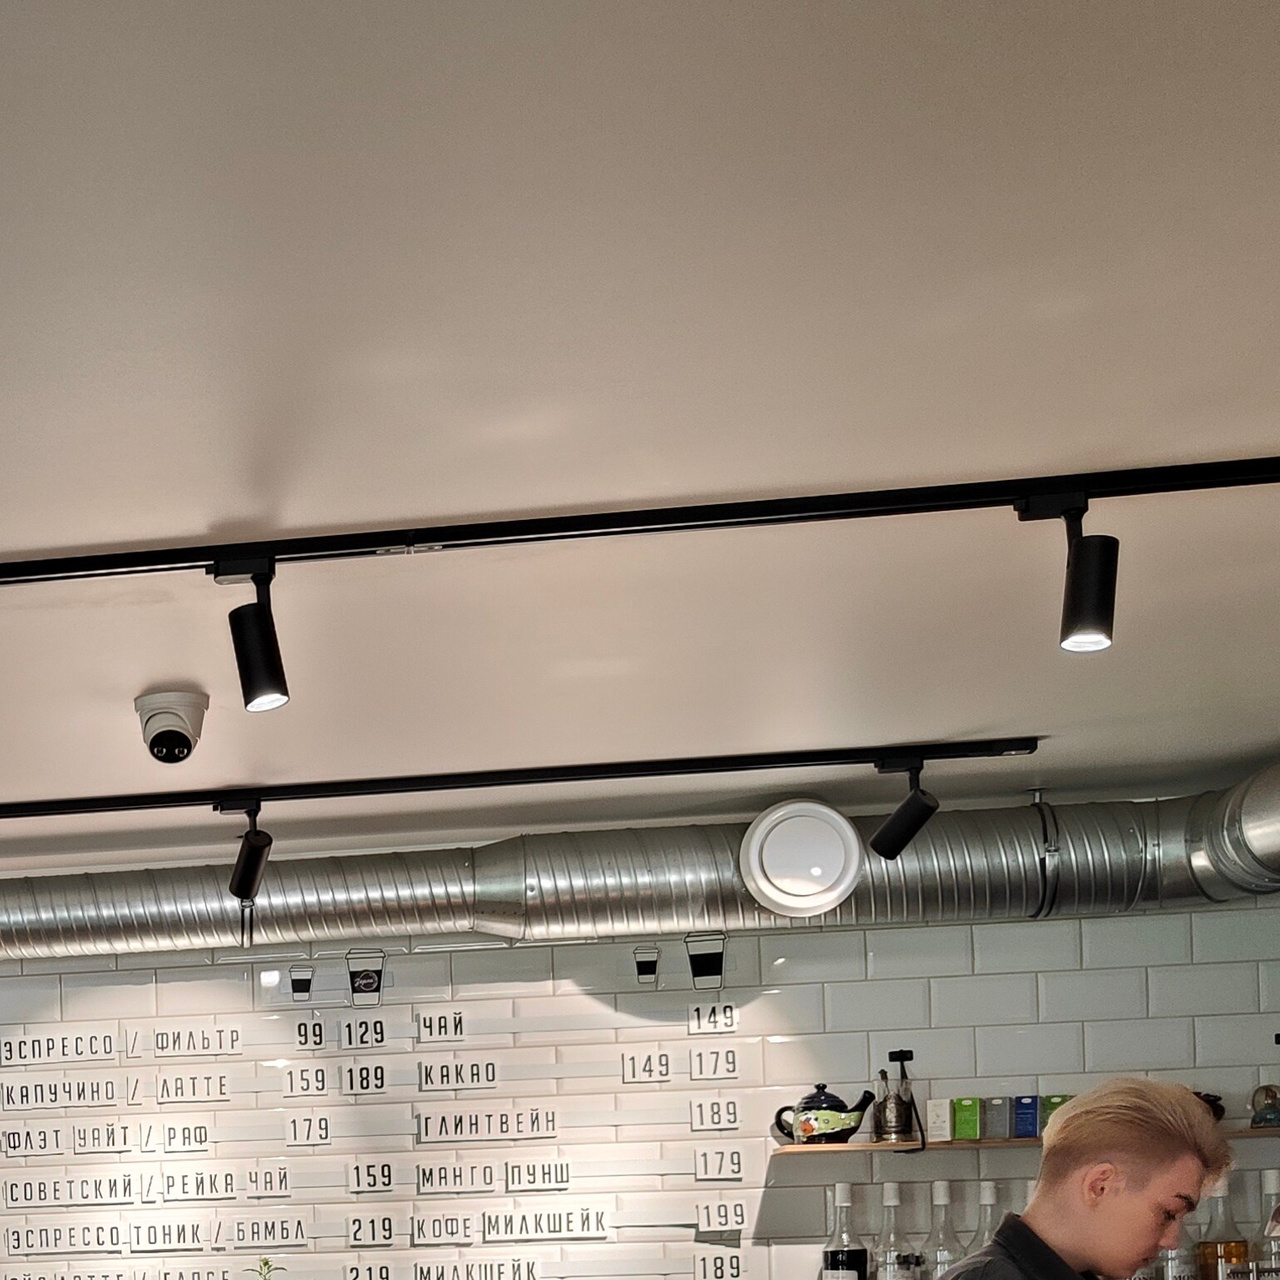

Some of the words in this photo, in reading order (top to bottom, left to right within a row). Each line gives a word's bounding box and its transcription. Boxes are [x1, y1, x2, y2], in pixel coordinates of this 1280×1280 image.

[423, 1012, 463, 1037] ЧАЙ
[693, 1005, 734, 1029] 149
[3, 1034, 114, 1060] ЭСПРЕССО
[156, 1029, 240, 1052] ФИЛЬТР
[298, 1022, 324, 1046] 99
[345, 1020, 385, 1045] 129
[425, 1062, 496, 1084] КАКАО
[629, 1054, 669, 1078] 149
[696, 1051, 736, 1074] 179
[6, 1081, 114, 1105] КАПУЧИНО
[160, 1075, 227, 1097] ЛАТТЕ
[287, 1069, 326, 1093] 159
[347, 1066, 385, 1091] 189
[8, 1129, 61, 1151] ФЛЭТ
[78, 1123, 129, 1147] УАЙТ
[168, 1125, 207, 1144] РАФ
[291, 1118, 329, 1141] 179
[425, 1108, 556, 1136] ГЛИНТВЕЙН
[697, 1102, 737, 1125] 189
[10, 1175, 132, 1201] СОВЕТСКИЙ
[166, 1171, 234, 1195] РЕЙКА
[248, 1167, 288, 1192] ЧАЙ
[353, 1164, 392, 1188] 159
[421, 1166, 493, 1187] МАНГО
[511, 1163, 570, 1185] ПУНШ
[700, 1151, 742, 1174] 179
[12, 1226, 119, 1249] ЭСПРЕССО
[134, 1223, 201, 1244] ТОНИК
[237, 1220, 304, 1242] БАМБЛ
[352, 1218, 392, 1241] 219
[416, 1217, 471, 1238] КОФЕ
[487, 1208, 605, 1235] МИЛКШЕЙК
[703, 1204, 744, 1227] 199
[699, 1256, 740, 1279] 189
